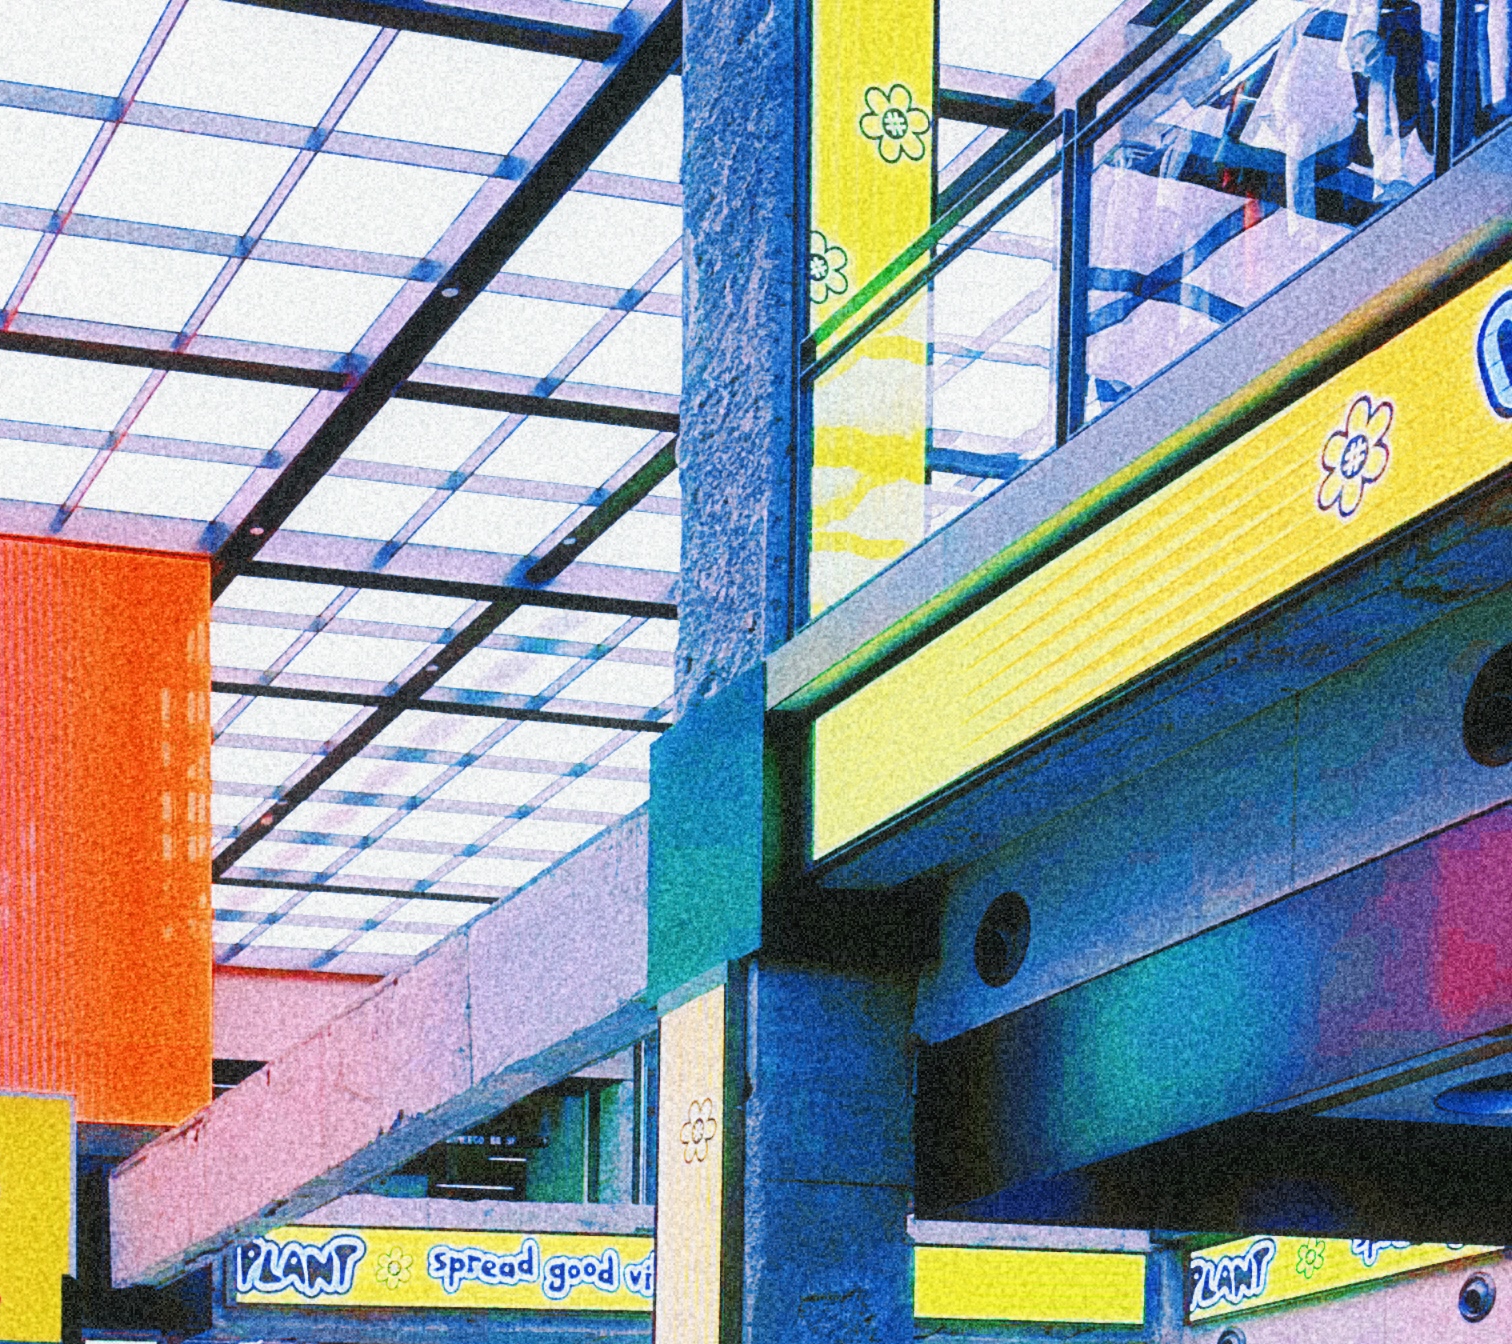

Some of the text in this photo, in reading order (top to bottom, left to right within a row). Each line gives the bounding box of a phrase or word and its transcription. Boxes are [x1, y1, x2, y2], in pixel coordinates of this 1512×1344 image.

[237, 1234, 655, 1300] PLANT spread good vi
